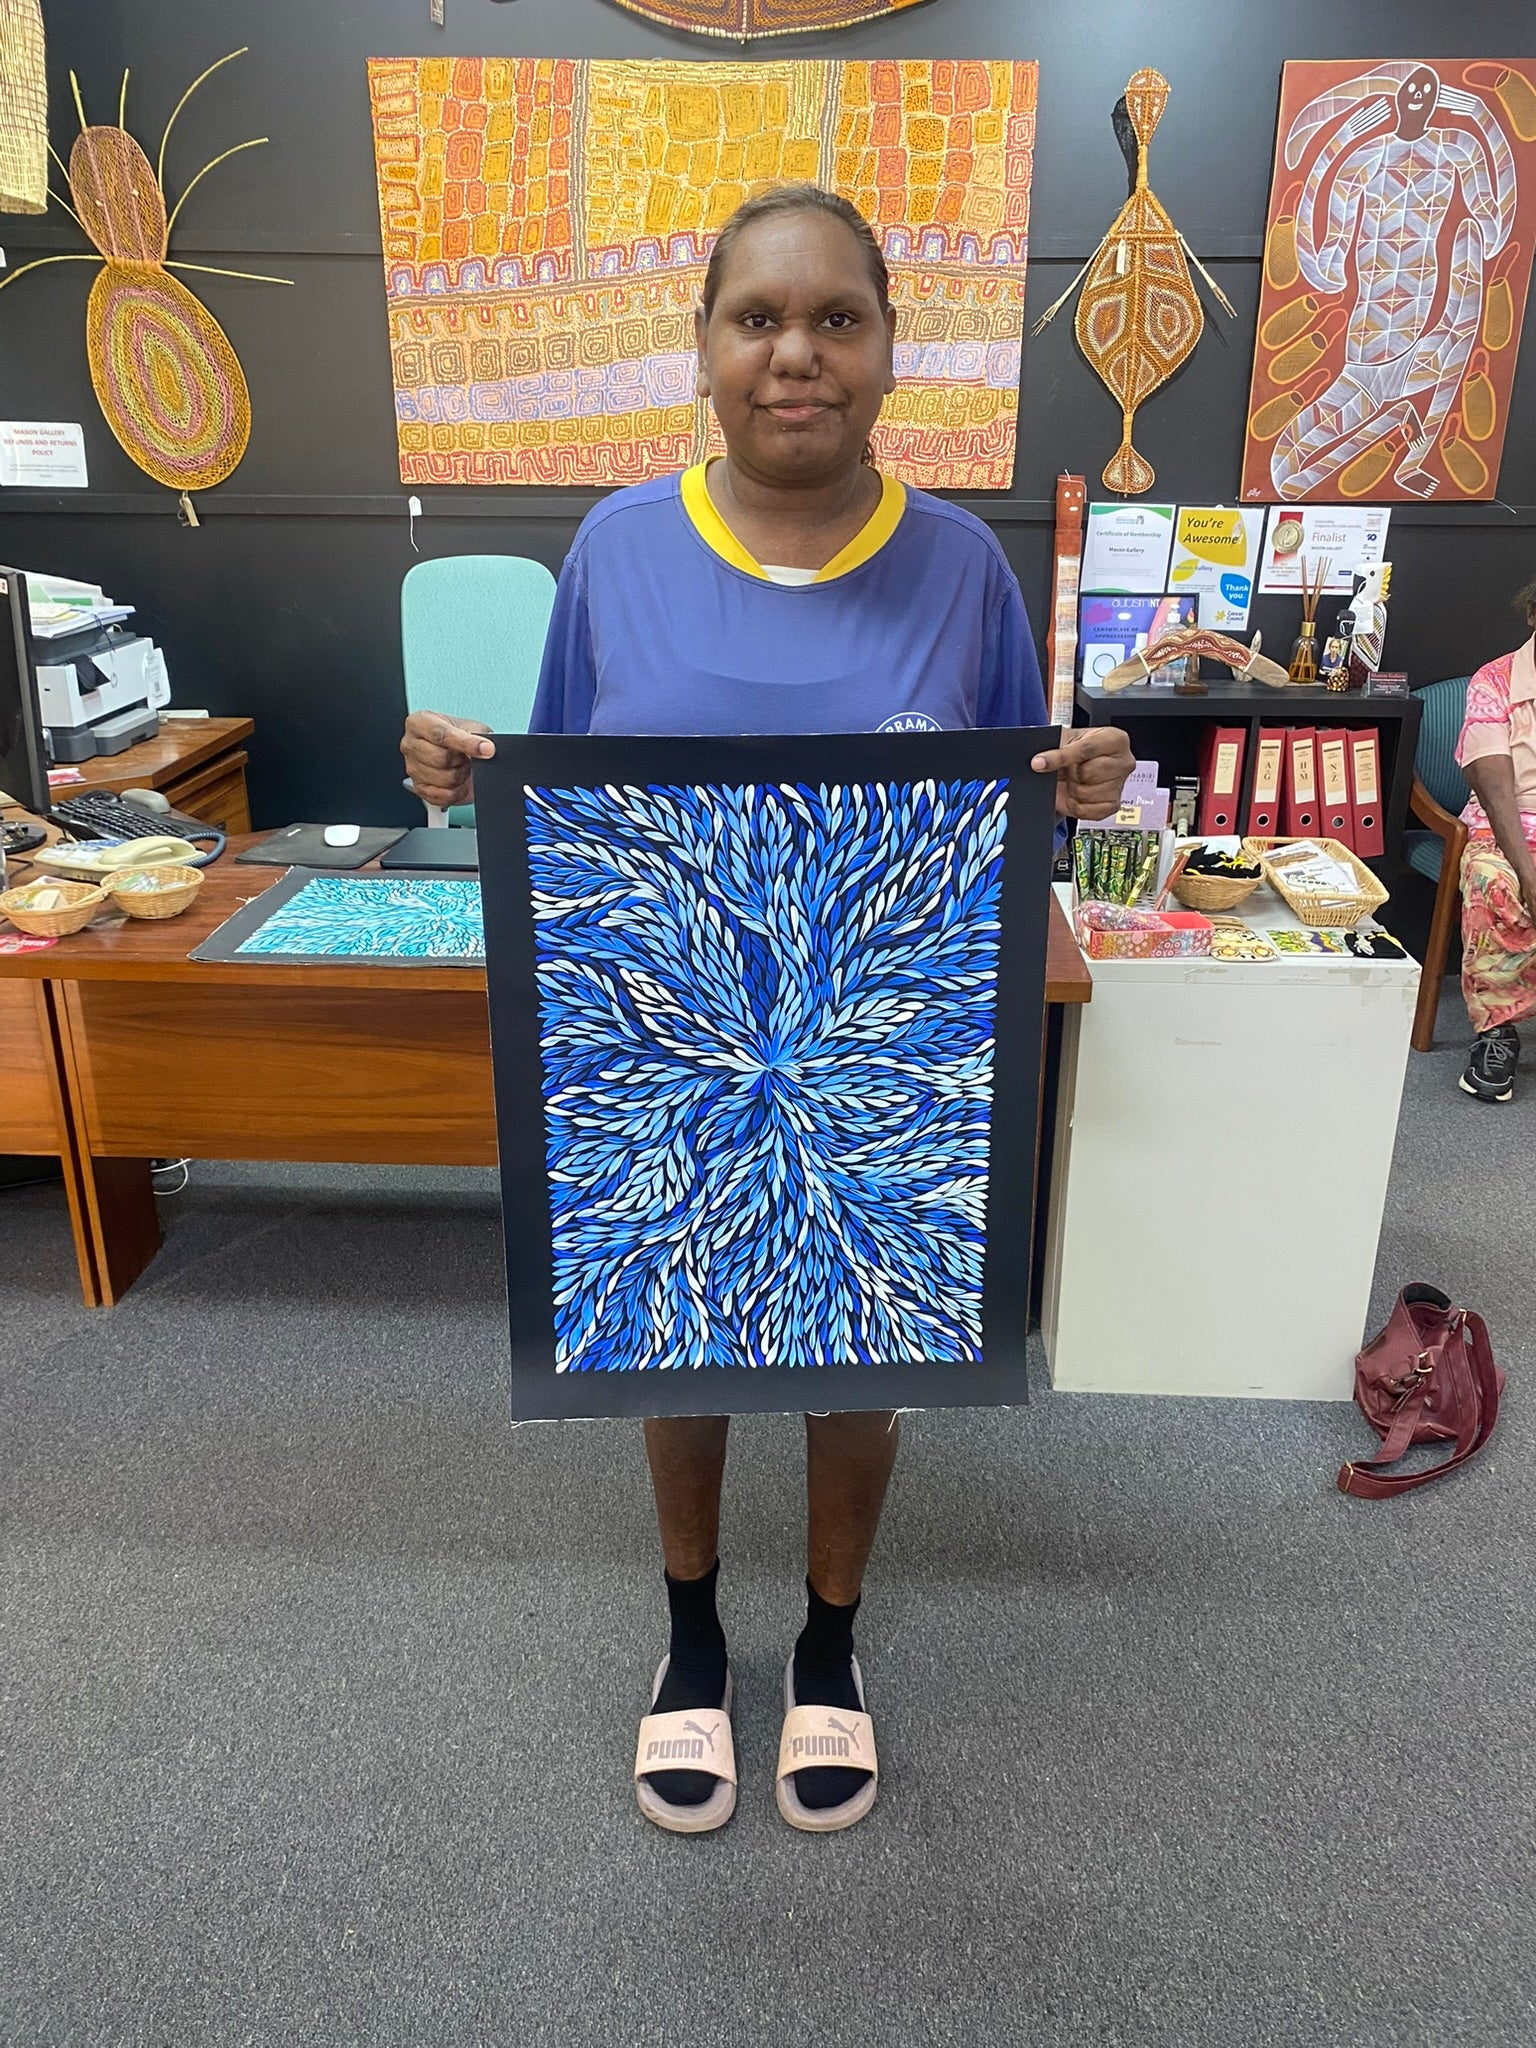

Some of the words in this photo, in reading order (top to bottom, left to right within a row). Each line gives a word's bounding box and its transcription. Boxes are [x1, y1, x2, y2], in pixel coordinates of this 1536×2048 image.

[1186, 517, 1224, 528] You're
[1312, 532, 1346, 543] Finalist
[1225, 584, 1249, 592] Thank
[1265, 761, 1272, 769] A
[1263, 773, 1271, 781] G
[646, 1738, 704, 1760] PUMA
[793, 1735, 850, 1758] PUMA
